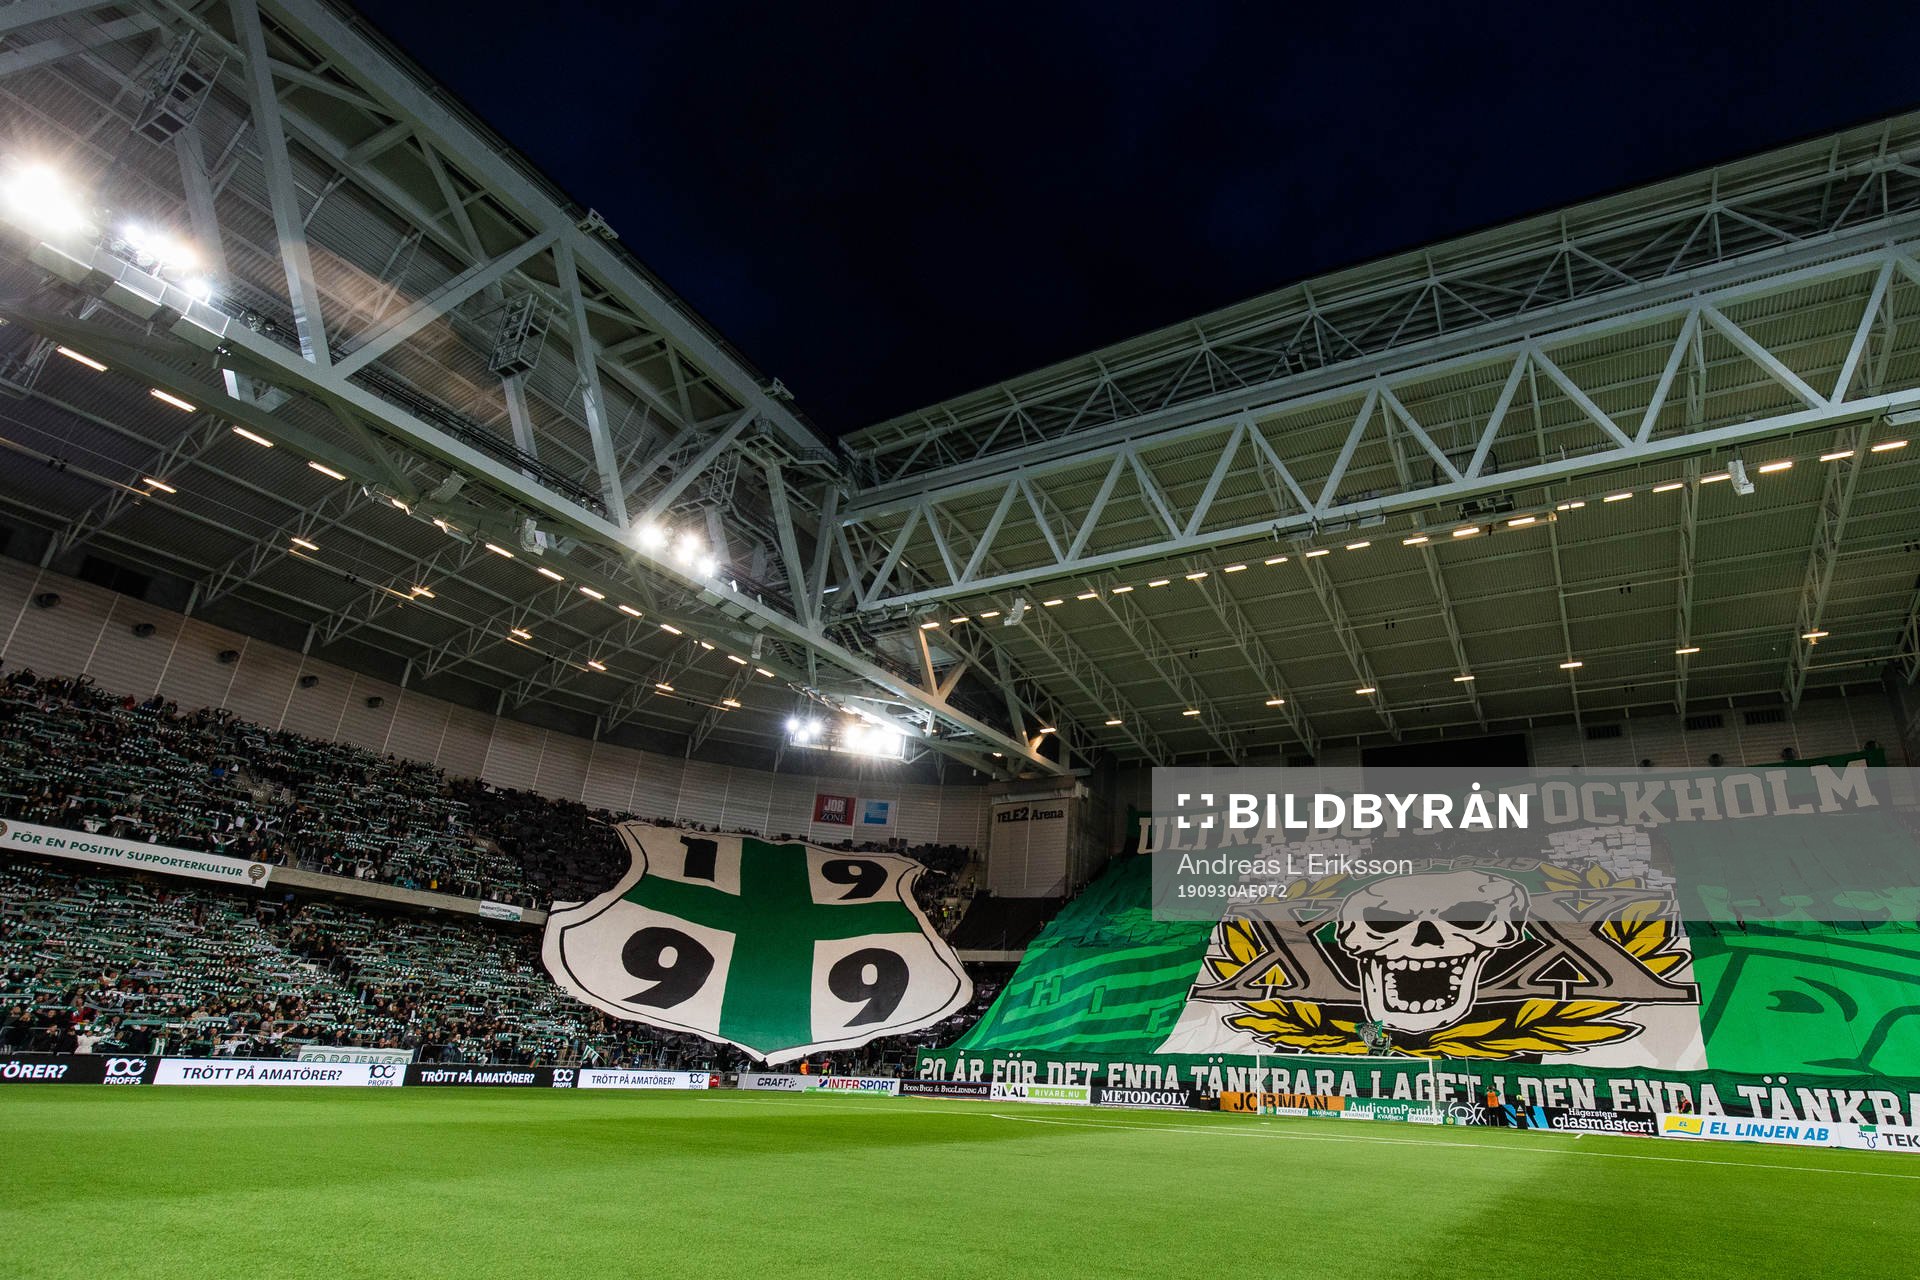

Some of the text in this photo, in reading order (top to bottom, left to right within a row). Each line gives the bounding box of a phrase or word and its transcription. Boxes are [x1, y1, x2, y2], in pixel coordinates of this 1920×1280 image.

[824, 799, 844, 812] JOB
[822, 814, 846, 823] ZONE
[997, 807, 1064, 822] TELE2 Arena
[12, 831, 243, 877] FÖR EN POSITIV SUPPORTERKULTUR
[182, 1065, 343, 1081] TRÖTT PÅ AMATÖRER?
[421, 1069, 535, 1083] TRÖTT PÅ AMATÖRER?
[592, 1074, 675, 1086] TRÖTT PÅ AMATÖRER?
[757, 1078, 789, 1088] CRAFT
[828, 1078, 895, 1091] INTERSPORT
[920, 1057, 946, 1081] 20
[953, 1051, 985, 1082] ÅR
[992, 1052, 1037, 1084] FÖR
[1047, 1062, 1100, 1086] DET
[1108, 1063, 1180, 1090] ENDA
[1371, 1070, 1481, 1103] LAGET
[1517, 1076, 1595, 1110] DEN
[1608, 1079, 1727, 1117] ENDA
[1736, 1075, 1920, 1128] TÄNKB
[992, 1083, 1080, 1098] RIVAL RIVARE.NU
[1100, 1089, 1189, 1105] METODGOLV
[1553, 1113, 1654, 1133] glasmästeri
[1710, 1122, 1829, 1141] EL LINJEN AB
